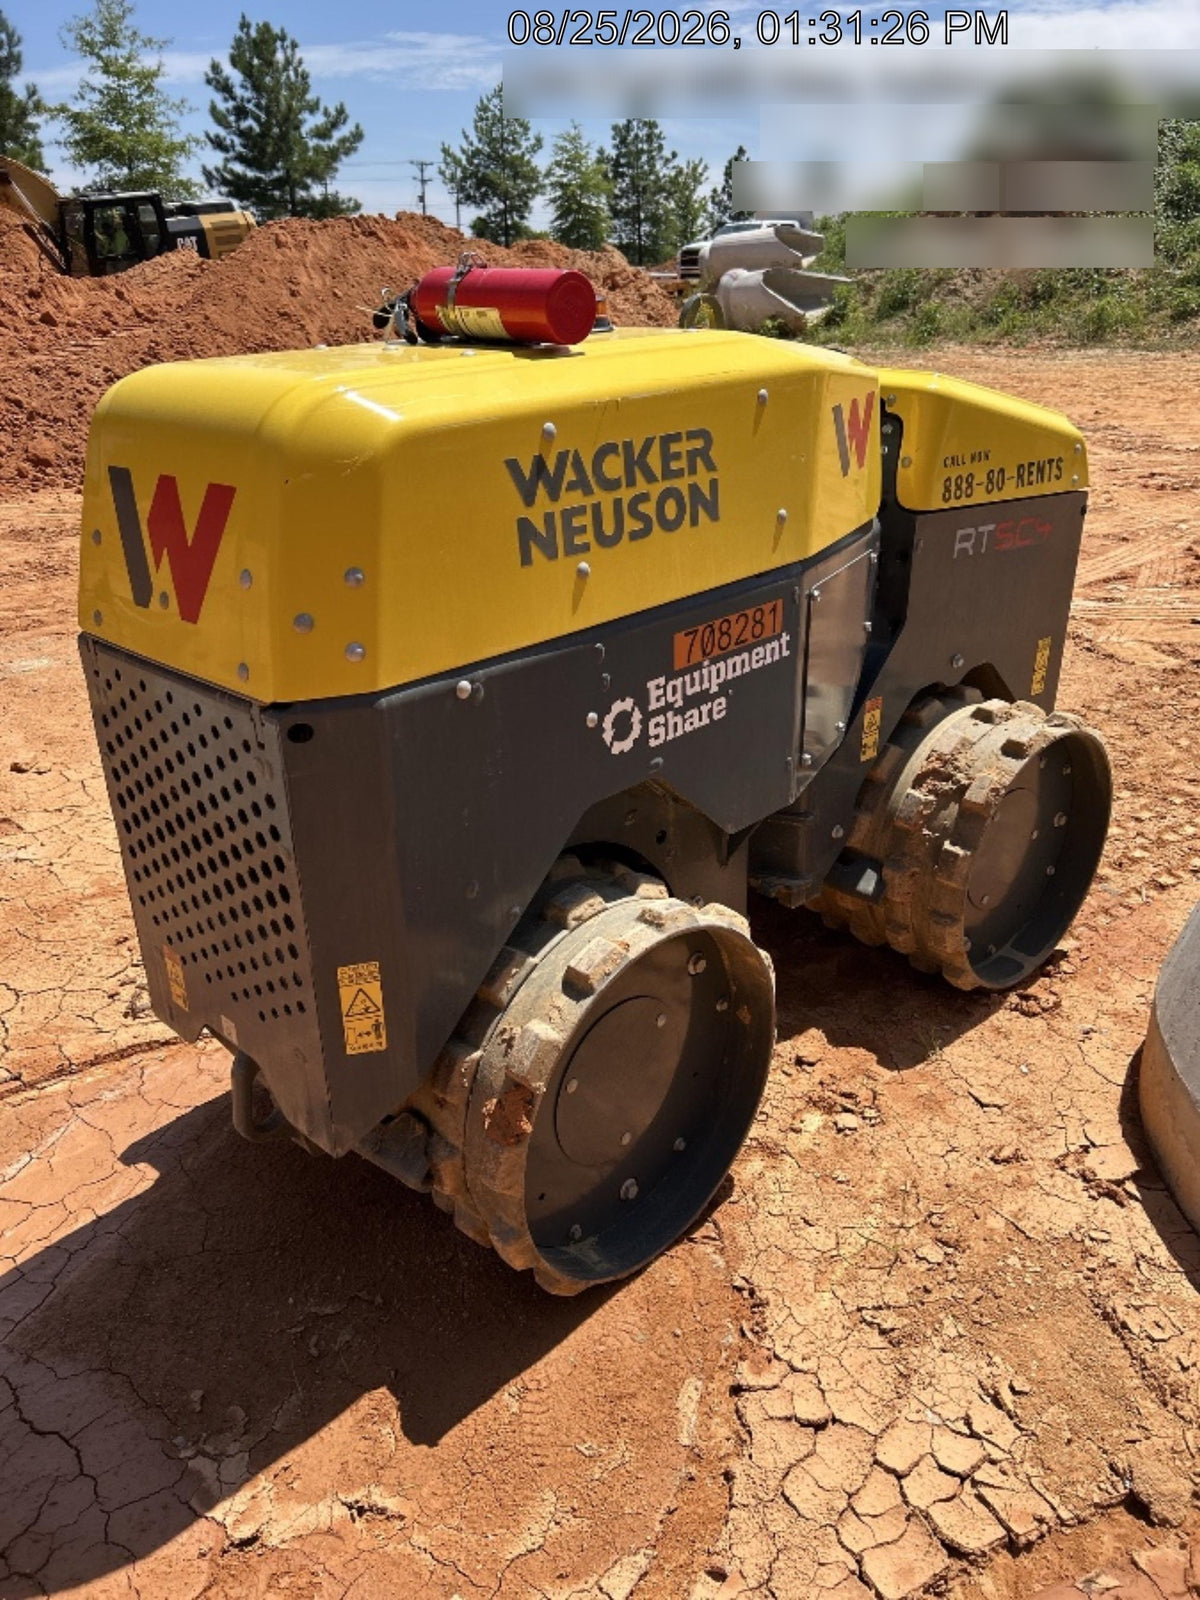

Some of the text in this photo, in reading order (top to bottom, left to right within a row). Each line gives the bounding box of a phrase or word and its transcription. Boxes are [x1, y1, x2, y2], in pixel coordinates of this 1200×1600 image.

[177, 236, 198, 251] CAT
[504, 428, 719, 507] WACKER
[942, 456, 1064, 503] 888-80-RENTS
[943, 455, 966, 468] CALL
[516, 477, 720, 567] NEUSON
[684, 602, 778, 663] 708281
[647, 632, 790, 711] Equipment
[648, 696, 727, 747] Share
